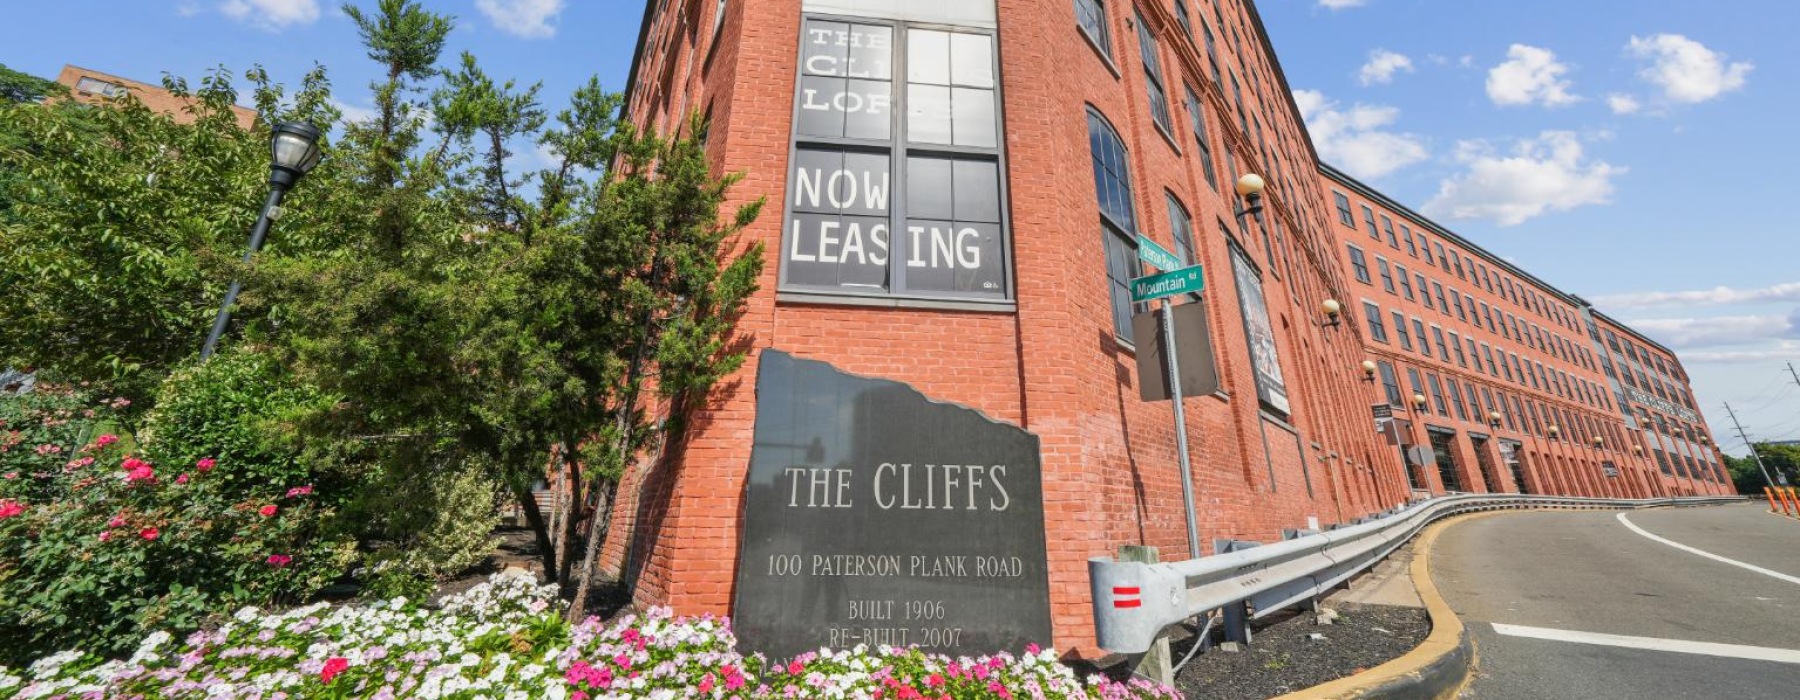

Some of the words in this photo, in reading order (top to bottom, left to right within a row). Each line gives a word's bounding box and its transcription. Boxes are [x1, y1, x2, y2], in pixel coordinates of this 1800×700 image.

[809, 28, 890, 49] THE
[802, 89, 922, 113] LOF
[795, 167, 889, 210] NOW
[791, 219, 980, 269] LEASING
[1136, 274, 1186, 297] Mountain
[785, 467, 853, 508] THE
[873, 462, 1011, 512] CLIFFS
[768, 554, 802, 576] 100
[811, 554, 901, 577] PATERSON
[910, 555, 968, 577] PLANK
[976, 556, 1023, 577] ROAD
[848, 600, 895, 620] BUILT
[905, 600, 946, 620] 1906
[829, 627, 910, 648] RE-BUILT
[921, 627, 963, 648] 2007
